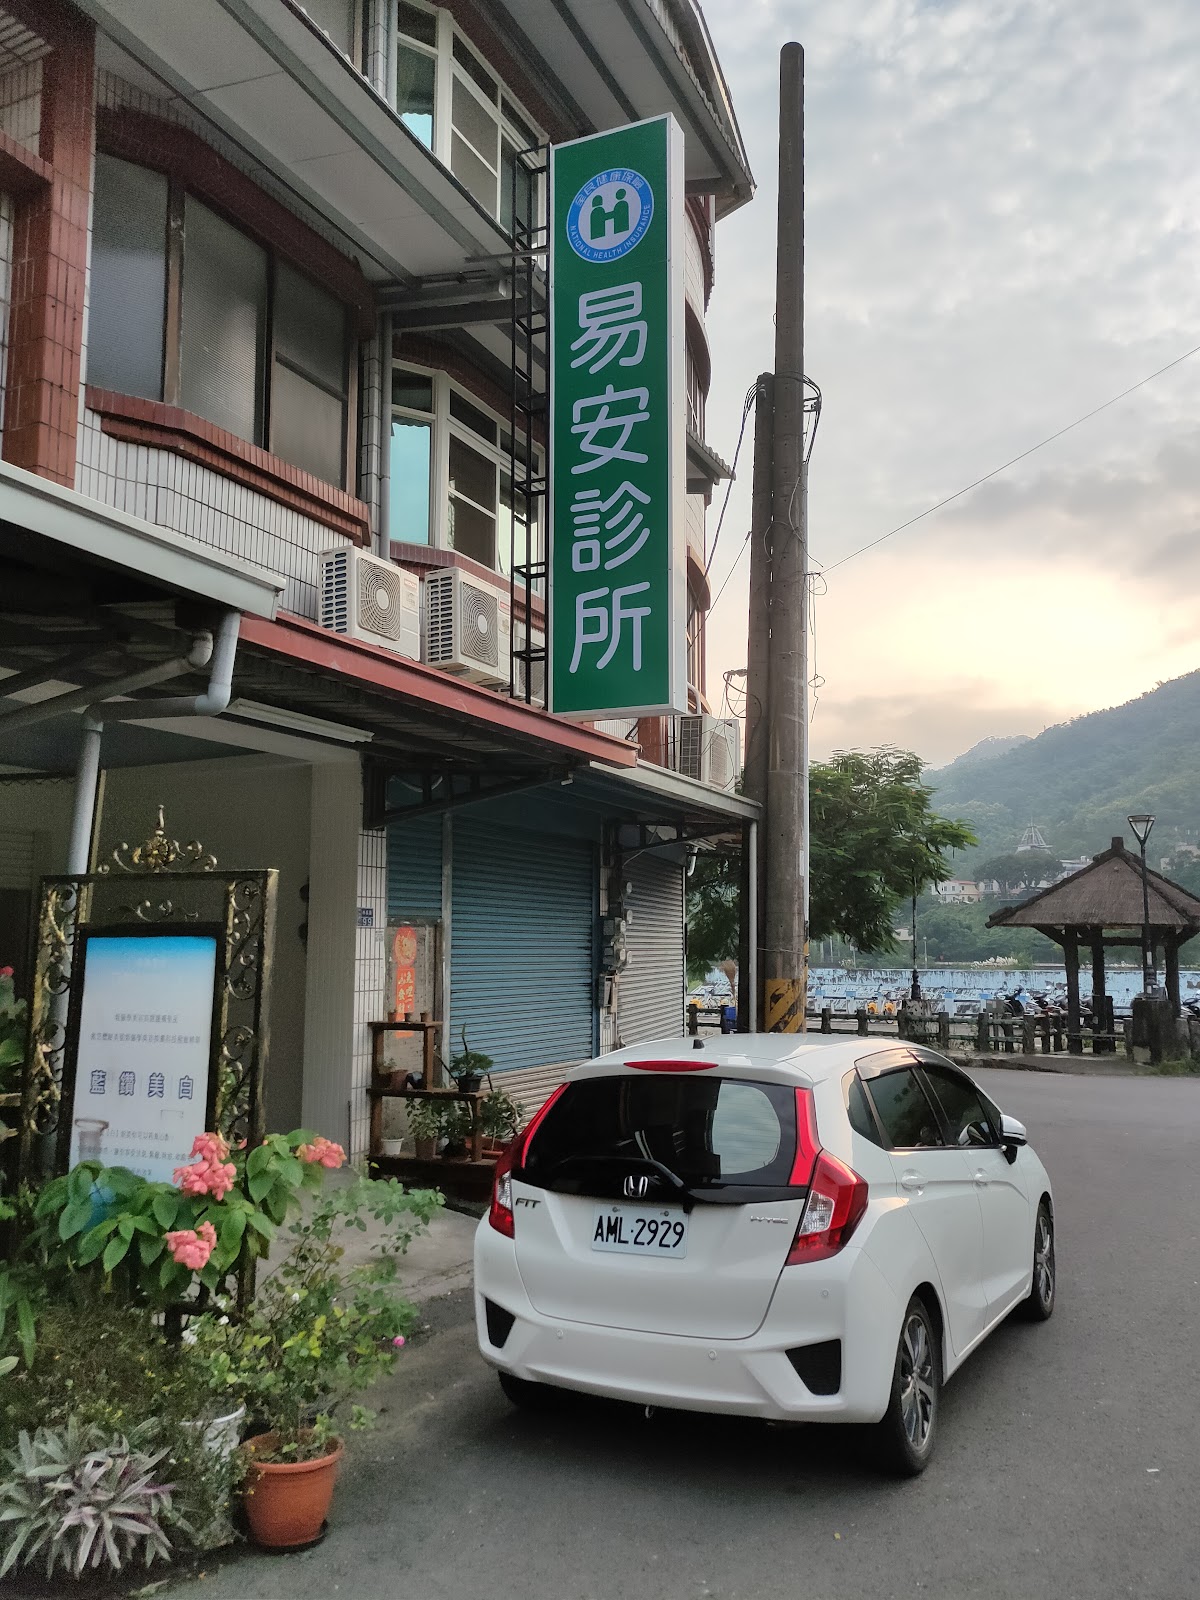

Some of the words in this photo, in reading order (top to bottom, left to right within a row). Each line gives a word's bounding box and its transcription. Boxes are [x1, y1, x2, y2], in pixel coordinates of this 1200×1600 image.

[575, 171, 645, 206] 全民健康保險
[570, 225, 591, 257] NATIONAL
[593, 248, 623, 259] HEALTH
[624, 203, 651, 250] INSURANCE
[570, 281, 652, 674] 易安診所
[515, 1197, 542, 1208] FIT
